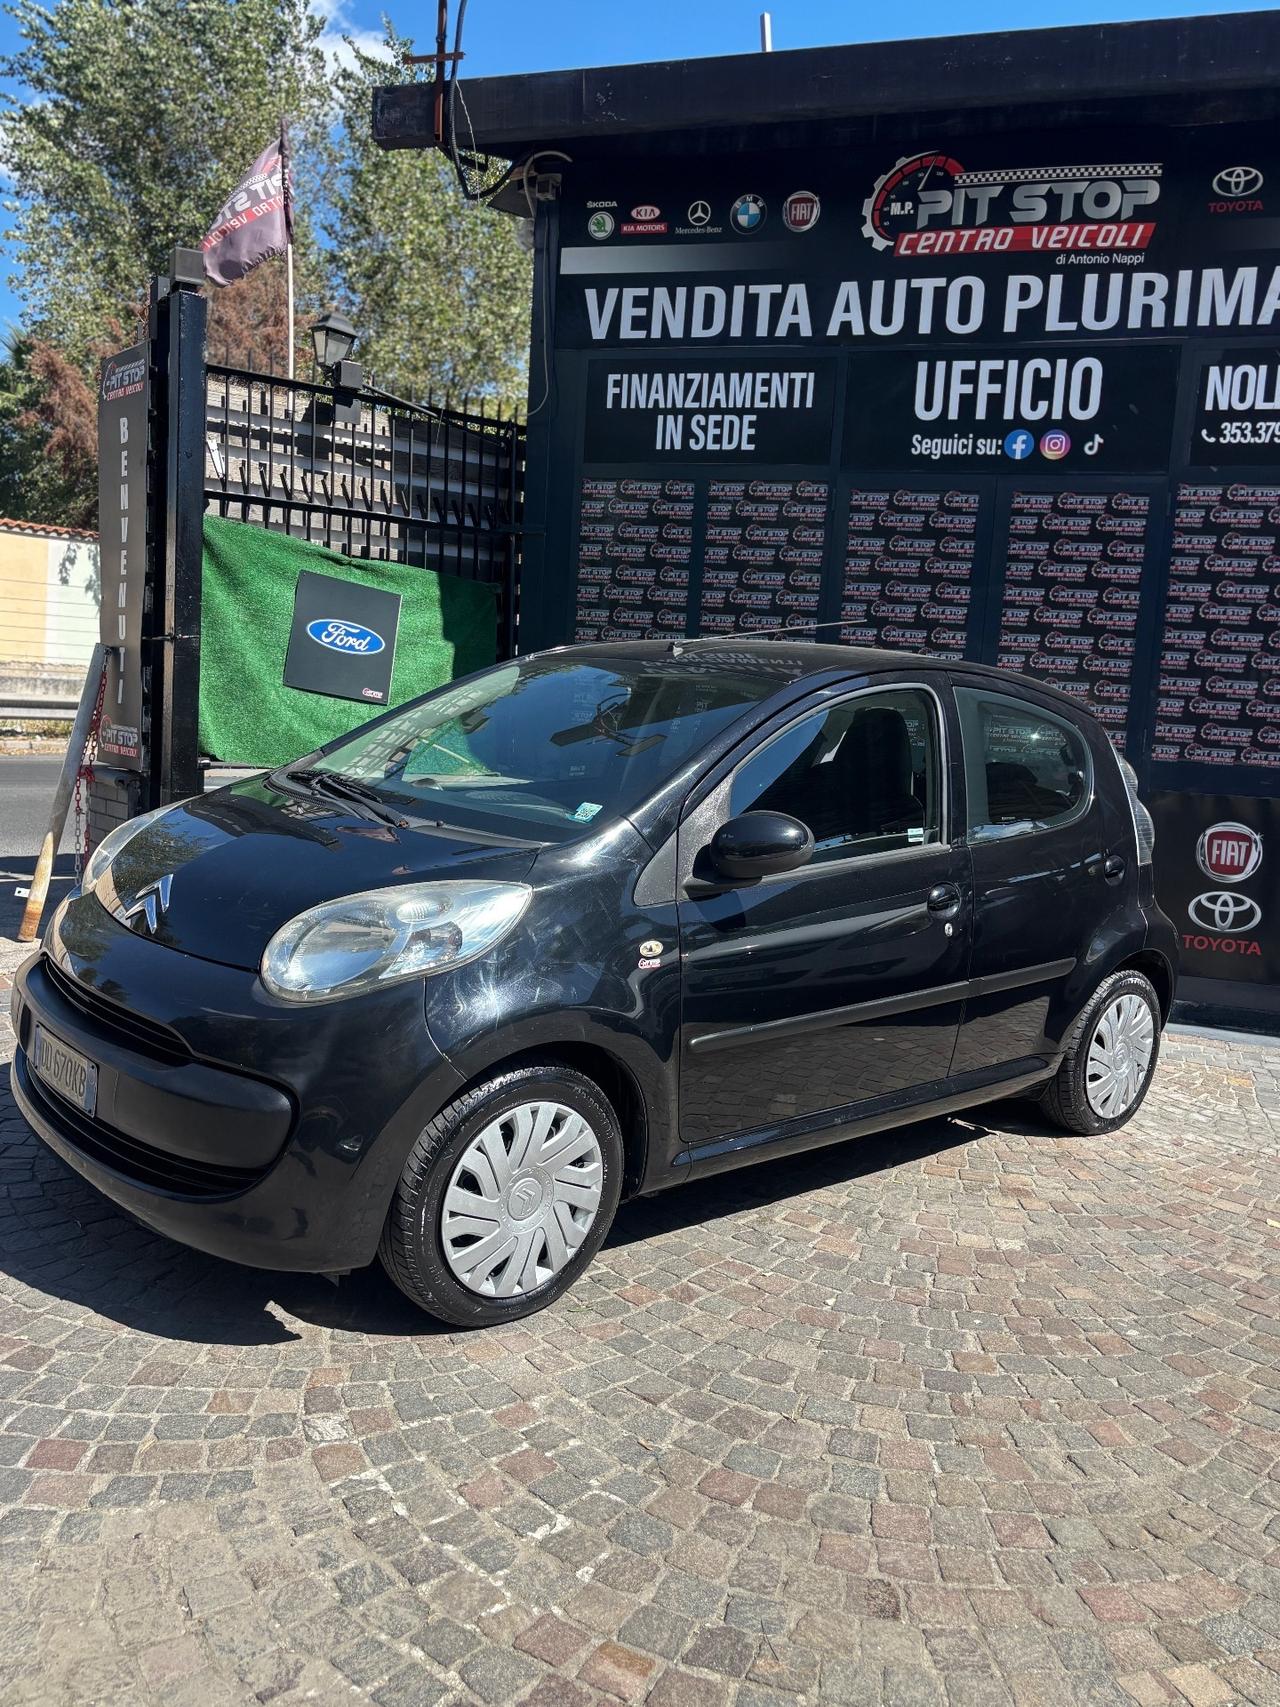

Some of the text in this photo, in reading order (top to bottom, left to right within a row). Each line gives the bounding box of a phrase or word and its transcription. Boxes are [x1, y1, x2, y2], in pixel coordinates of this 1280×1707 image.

[890, 179, 1160, 230] M.P. PIT STOP
[1208, 200, 1263, 213] TOYOTA
[636, 208, 655, 218] KIA
[791, 203, 813, 221] FIAT
[636, 223, 665, 232] MOTORS
[900, 224, 1146, 255] CENTRO VEICOLI
[1056, 253, 1144, 266] di Antonio Nappi
[584, 284, 813, 339] VENDITA
[826, 275, 985, 336] AUTO
[123, 365, 145, 386] STOP
[606, 372, 815, 409] FINANZIAMENTI
[914, 357, 1103, 421] UFFICIO
[1204, 364, 1280, 411] NOL
[655, 414, 757, 451] IN SEDE
[911, 434, 1002, 460] Seguici su:
[1180, 488, 1223, 497] PIT STOP
[866, 494, 890, 502] STOP
[916, 495, 940, 503] STOP
[1014, 497, 1054, 505] PIT STOP
[1068, 498, 1107, 506] PIT STOP
[1221, 511, 1264, 520] PIT STOP
[953, 517, 976, 525] STOP
[1106, 520, 1146, 528] PIT STOP
[912, 541, 935, 549] STOP
[1191, 537, 1218, 545] STOP
[1010, 543, 1050, 552] PIT STOP
[1078, 545, 1103, 553] STOP
[117, 417, 129, 704] BENVENUTI
[898, 561, 921, 569] STOP
[1231, 560, 1258, 568] STOP
[1102, 567, 1141, 575] PIT STOP
[908, 586, 931, 594] STOP
[1170, 584, 1212, 593] PIT STOP
[1227, 586, 1270, 595] PIT STOP
[1021, 590, 1045, 598] STOP
[894, 606, 917, 614] STOP
[1226, 608, 1252, 616] STOP
[1043, 612, 1083, 620] PIT STOP
[1097, 614, 1137, 622] PIT STOP
[321, 622, 371, 651] Ford
[855, 629, 878, 637] STOP
[904, 631, 927, 639] STOP
[1165, 632, 1207, 641] PIT STOP
[1016, 636, 1041, 644] STOP
[1221, 634, 1264, 643] PIT STOP
[1039, 658, 1079, 666] PIT STOP
[1204, 655, 1247, 664] PIT STOP
[1093, 660, 1132, 669] PIT STOP
[1216, 682, 1259, 691] PIT STOP
[1215, 703, 1242, 711] STOP
[1211, 729, 1254, 738] PIT STOP
[1211, 839, 1250, 867] FIAT
[1182, 934, 1262, 955] TOYOTA
